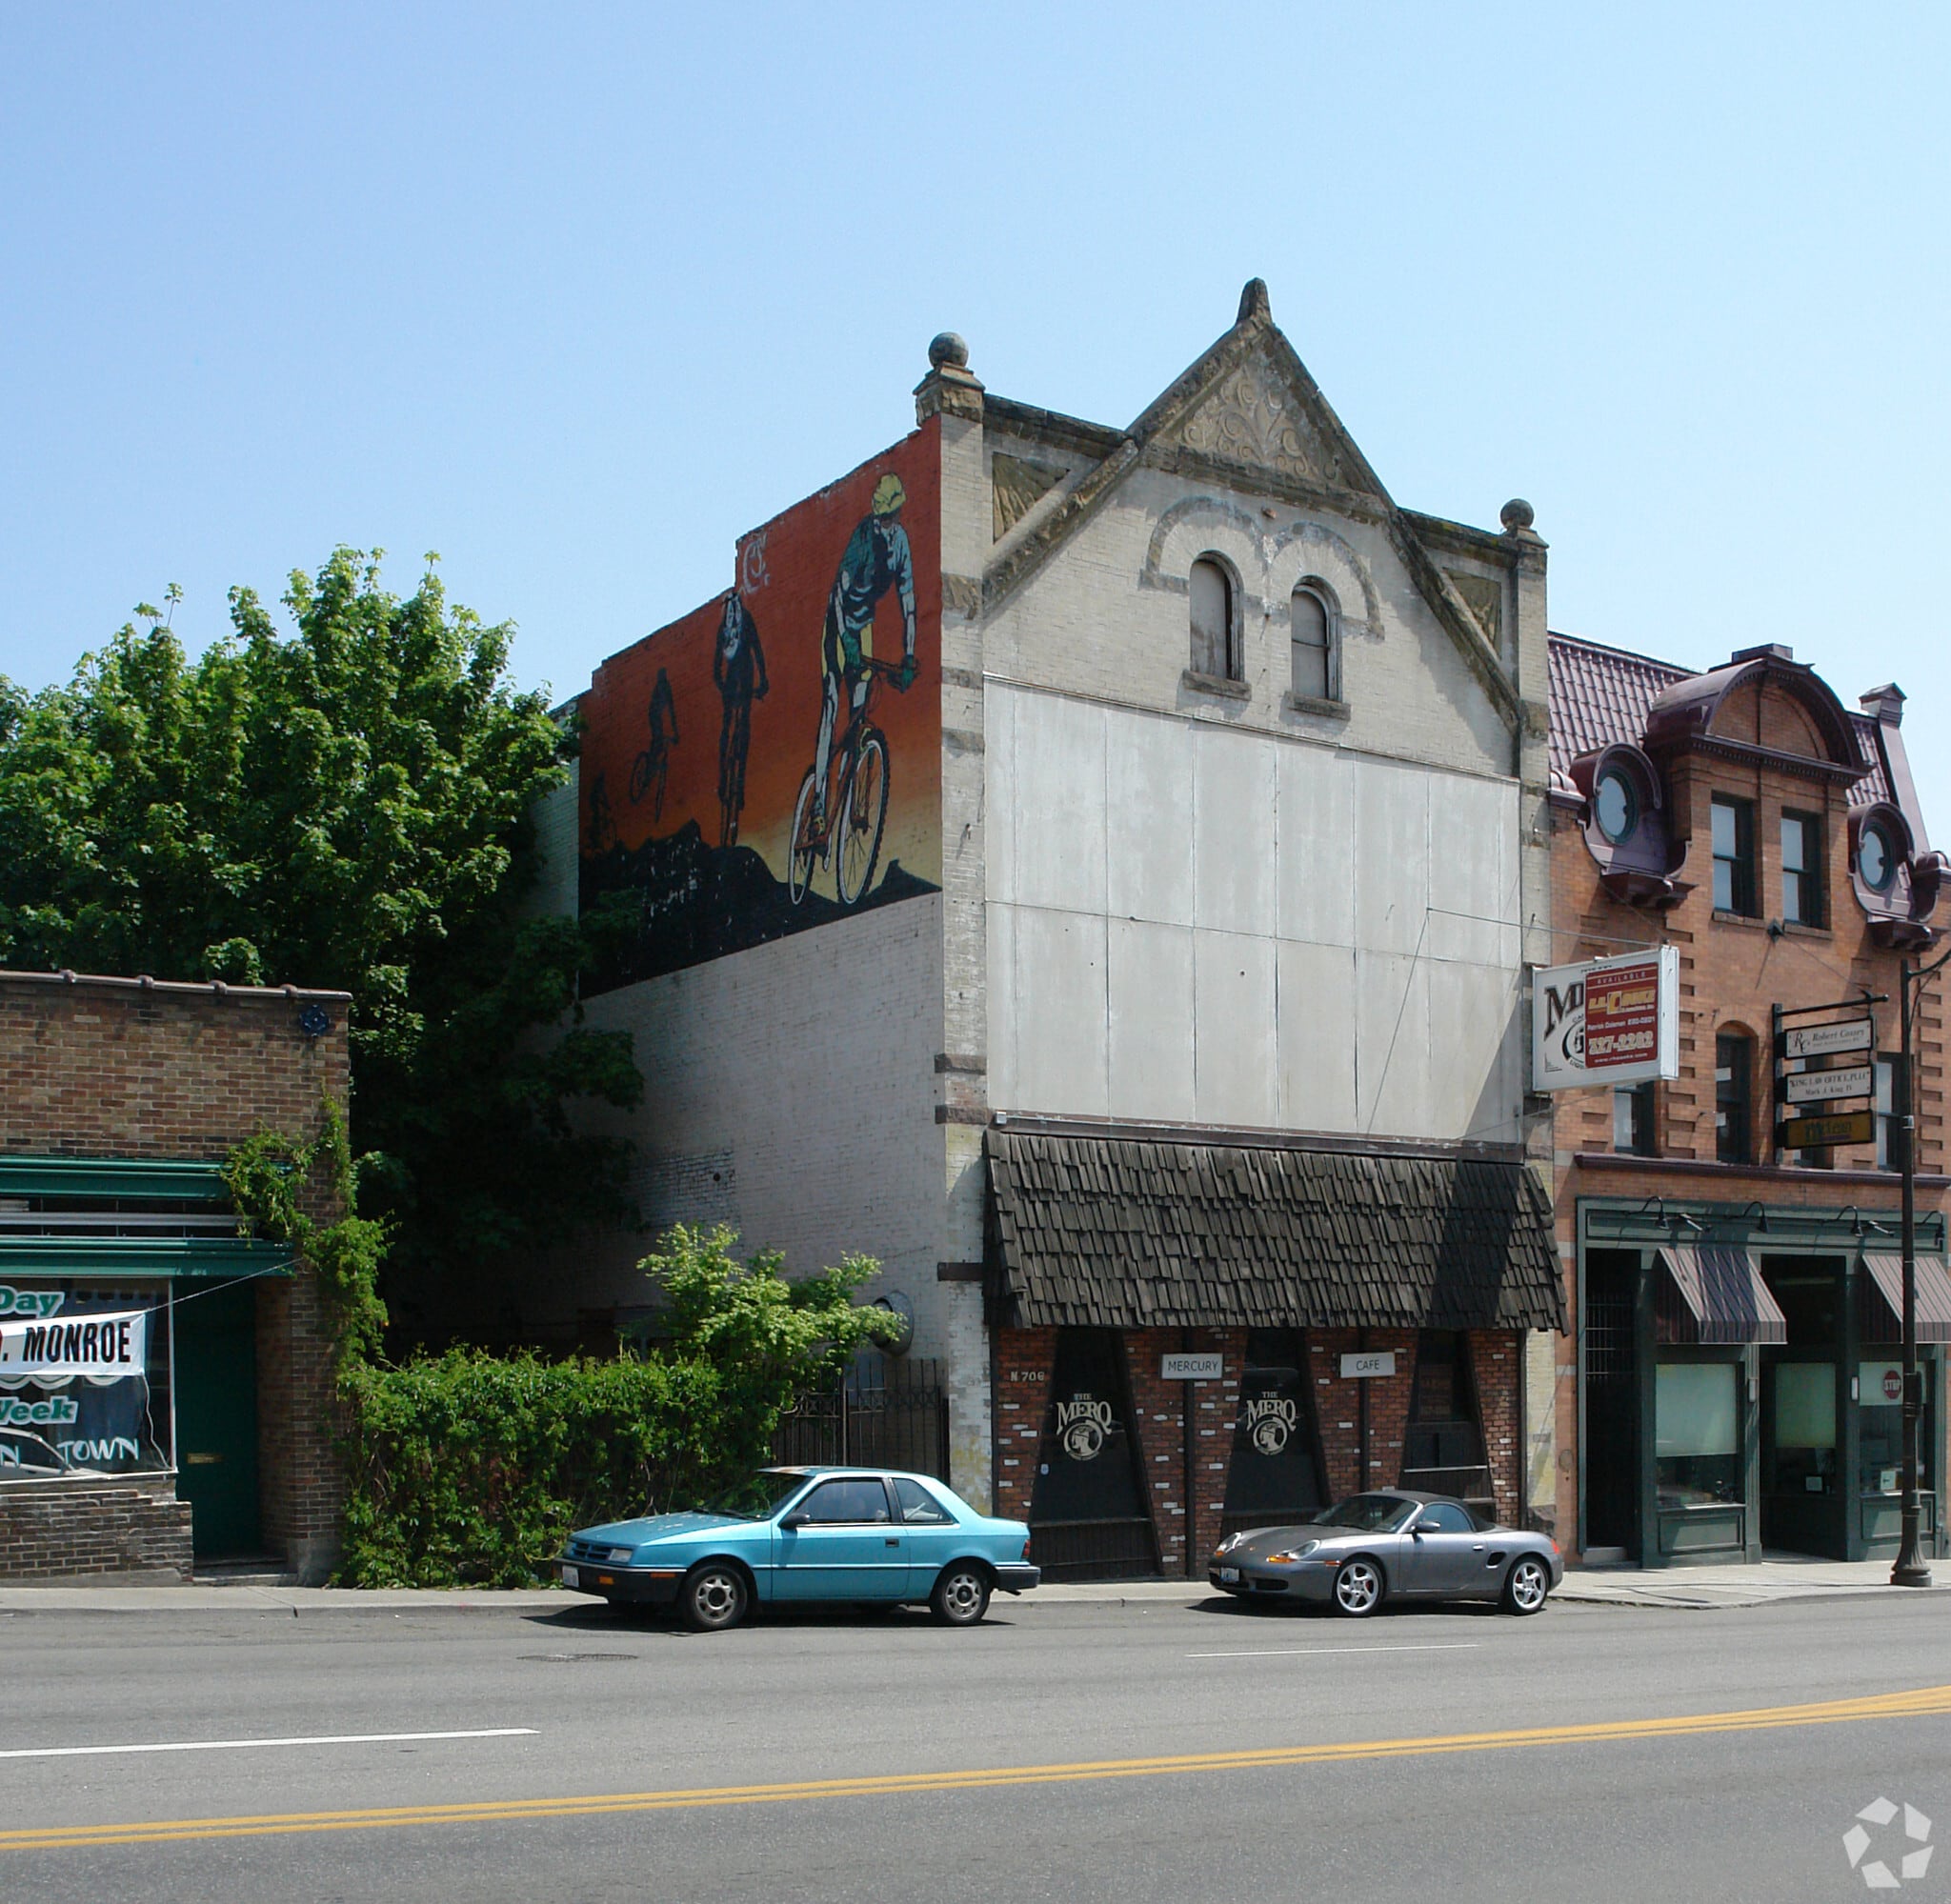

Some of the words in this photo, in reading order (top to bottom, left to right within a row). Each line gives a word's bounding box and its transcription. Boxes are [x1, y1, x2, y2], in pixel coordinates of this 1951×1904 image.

[23, 1321, 131, 1362] MONROE
[1168, 1360, 1218, 1372] MERCURY
[1356, 1359, 1380, 1372] CAFE
[1883, 1378, 1901, 1391] STOP
[1074, 1393, 1092, 1401] THE
[1056, 1401, 1112, 1435] MERQ
[1246, 1399, 1297, 1432] MERQ
[57, 1436, 140, 1466] TOWN
